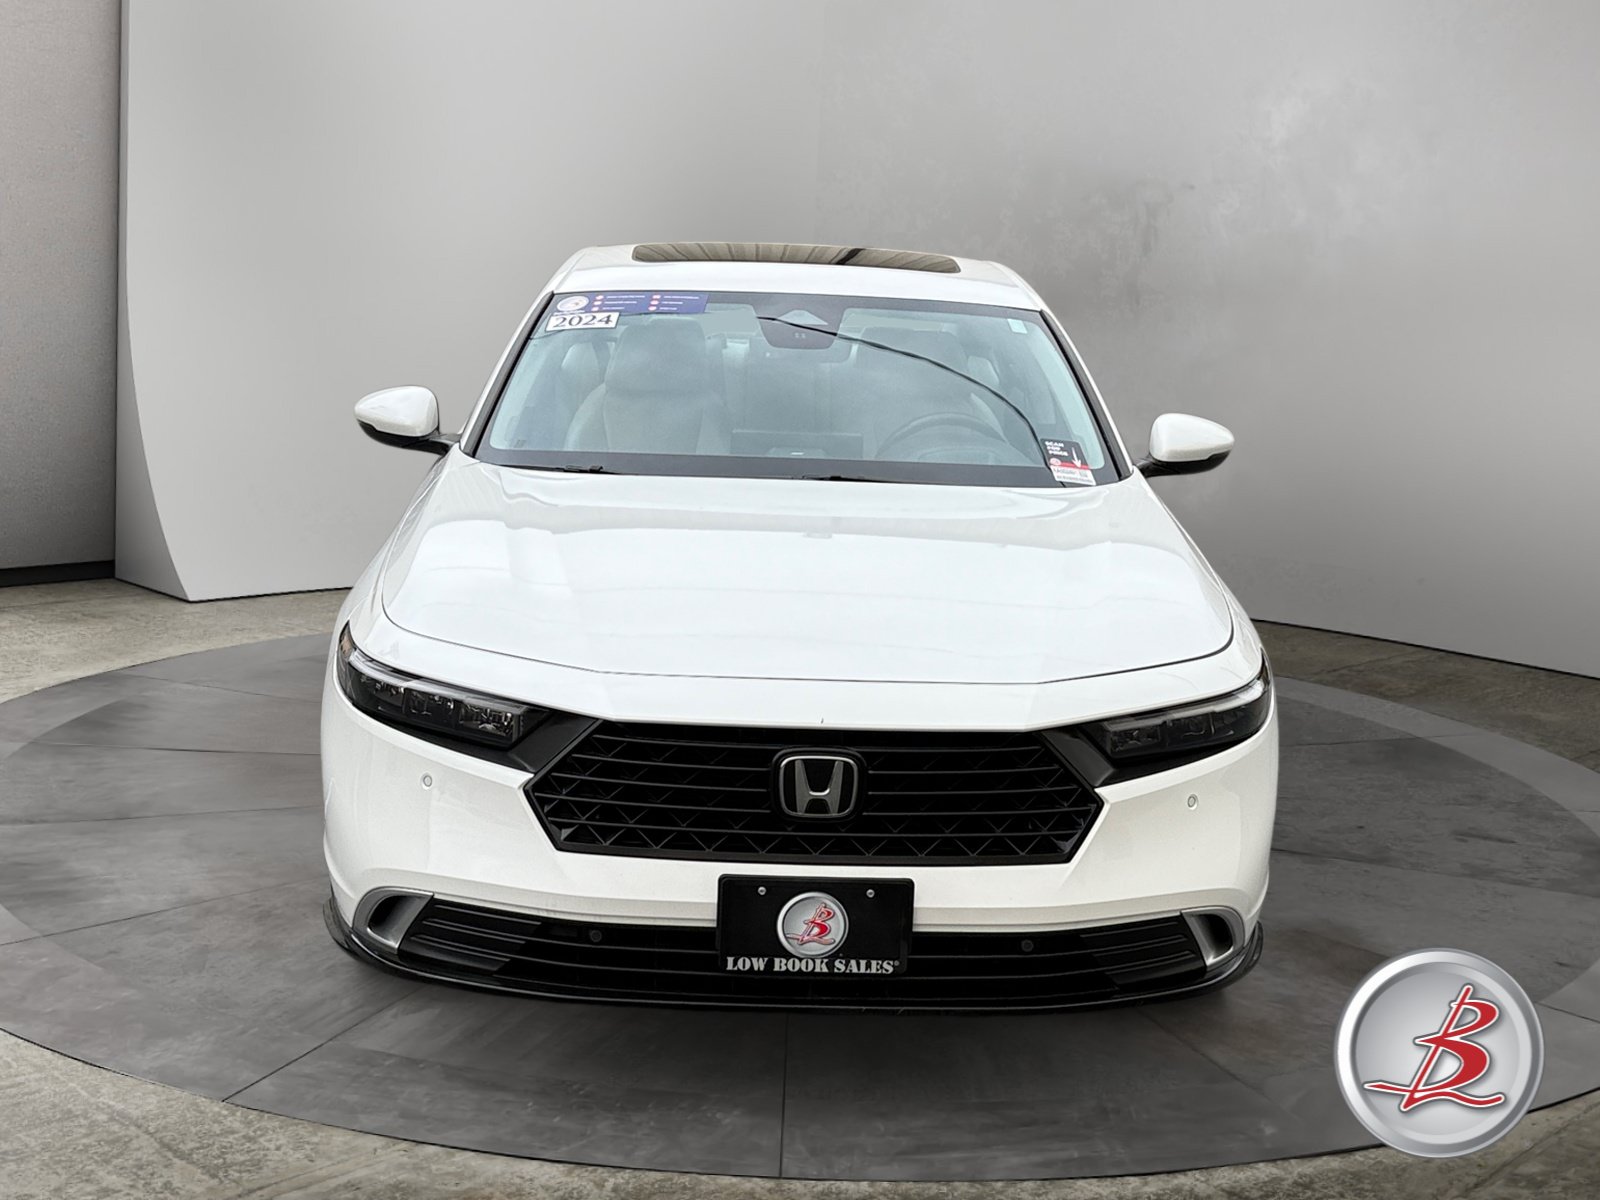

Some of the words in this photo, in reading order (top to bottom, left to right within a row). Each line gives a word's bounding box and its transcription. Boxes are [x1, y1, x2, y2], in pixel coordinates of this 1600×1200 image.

[553, 314, 613, 328] 2024
[726, 957, 769, 971] LOW
[773, 957, 829, 973] BOOK
